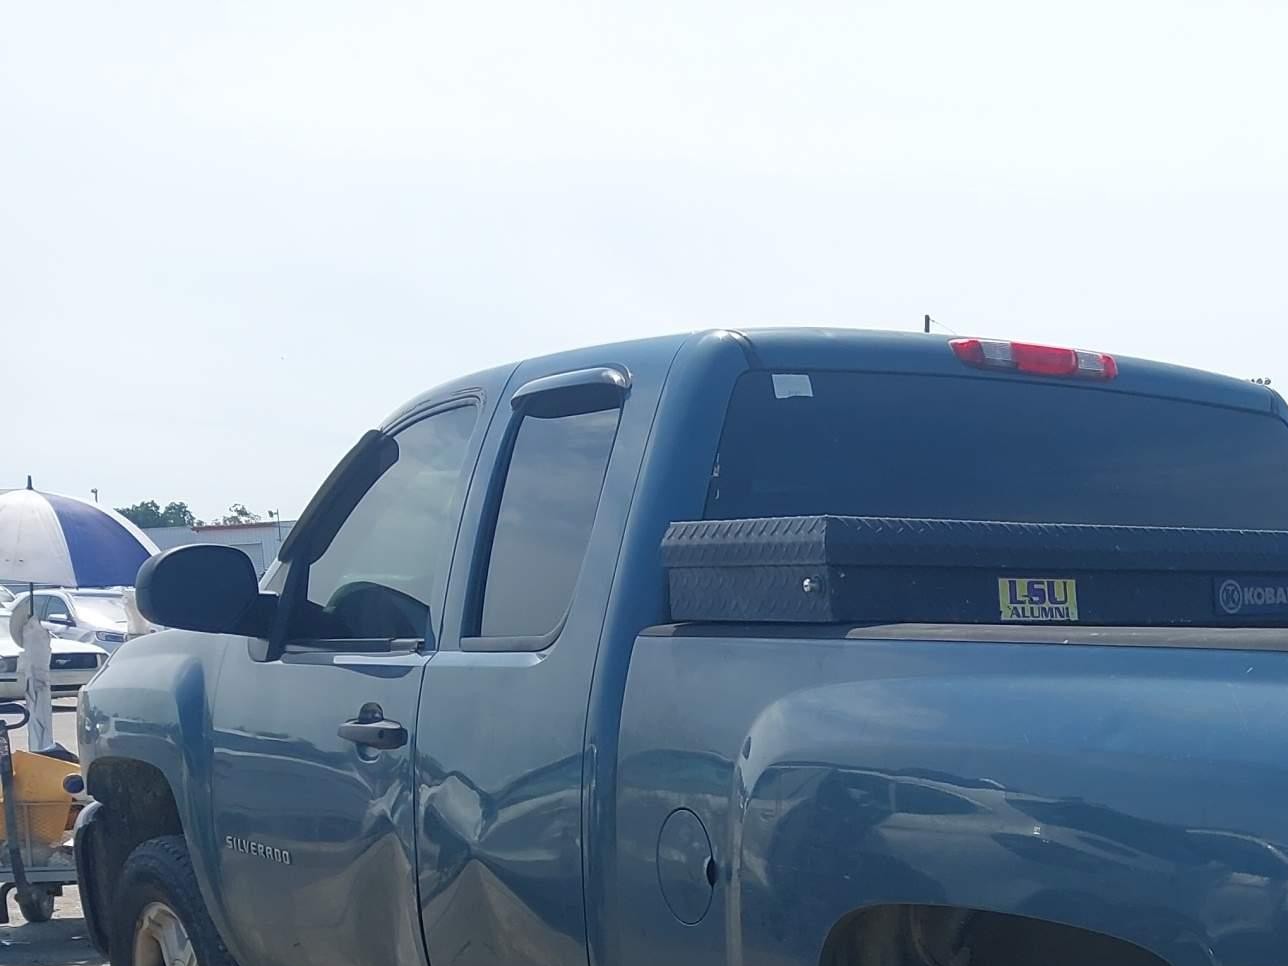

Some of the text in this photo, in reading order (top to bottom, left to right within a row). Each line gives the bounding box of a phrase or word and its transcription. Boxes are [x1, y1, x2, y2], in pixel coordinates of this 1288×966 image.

[1008, 580, 1068, 604] LSU
[1009, 606, 1070, 619] ALUMNI
[225, 835, 291, 865] SILVERADO
